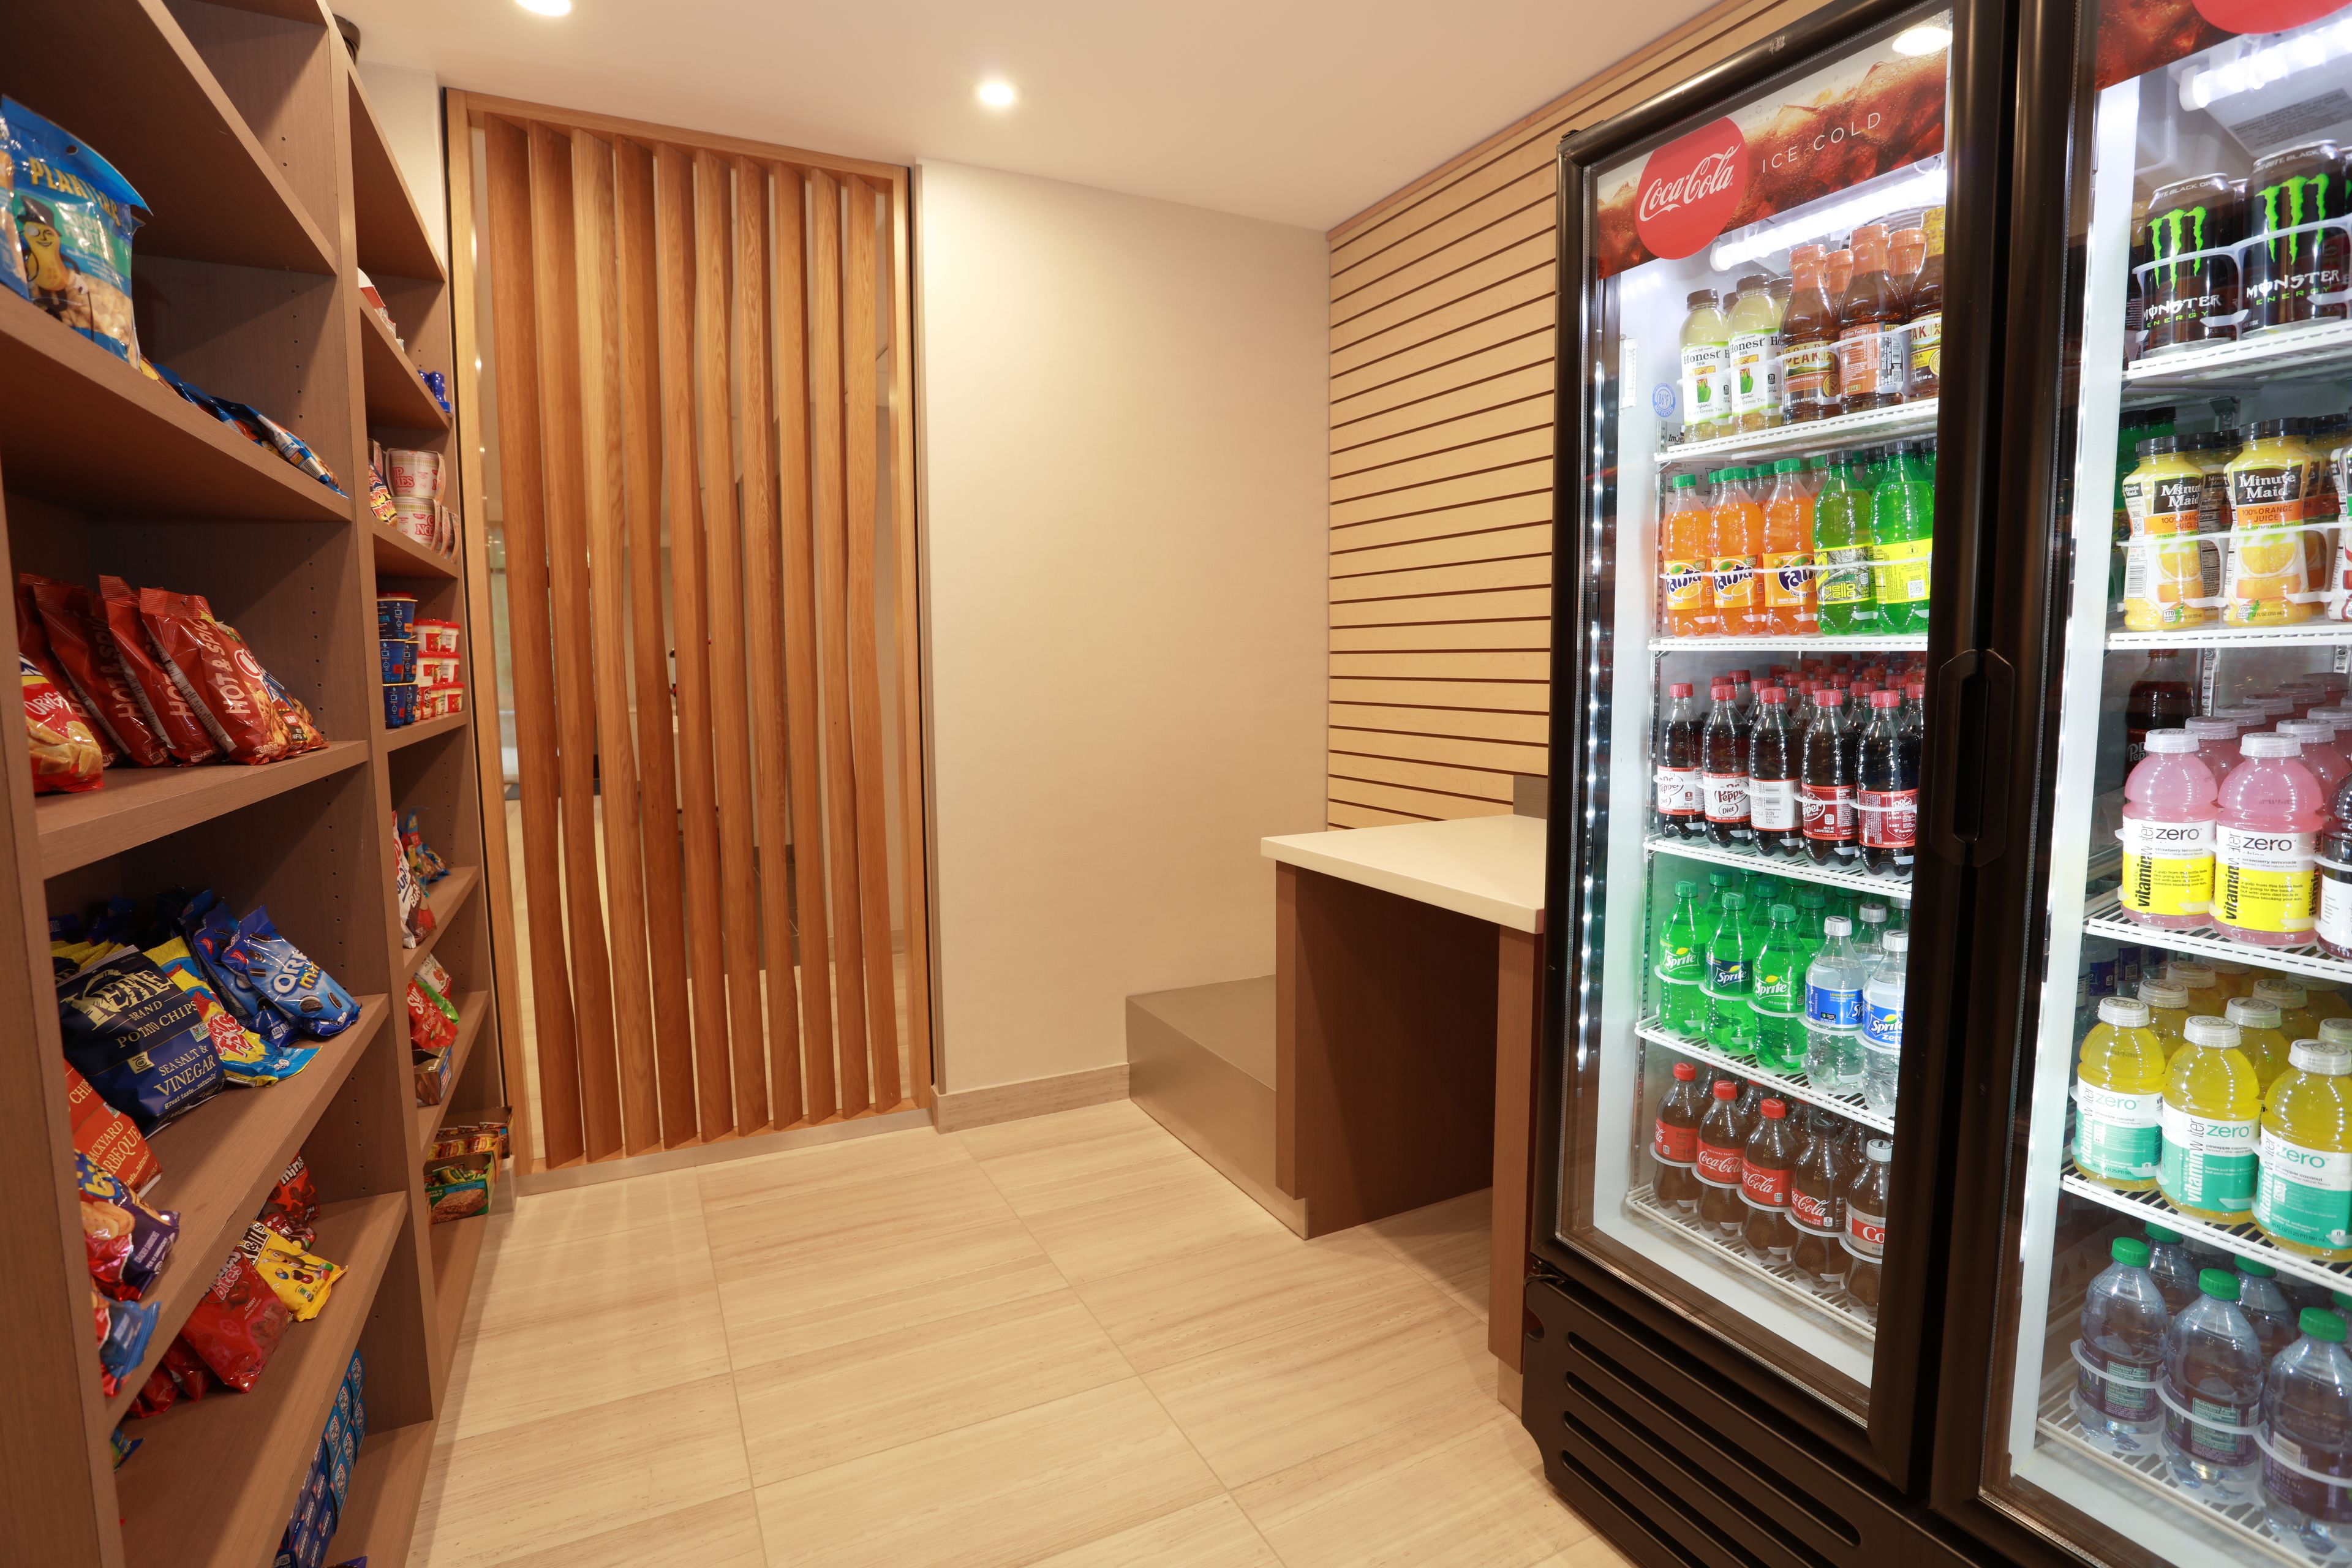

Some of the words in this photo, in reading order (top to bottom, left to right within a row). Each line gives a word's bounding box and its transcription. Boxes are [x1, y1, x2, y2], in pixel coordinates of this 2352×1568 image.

[1762, 148, 1797, 173] ICE
[1814, 112, 1882, 151] COLD
[1639, 142, 1741, 222] Coca-Cola
[2169, 183, 2198, 196] BLACK
[2247, 270, 2340, 299] MONSTER
[2256, 286, 2330, 306] ENERGY
[2144, 294, 2222, 322] MONSTER
[2147, 311, 2209, 328] ENERGY
[1730, 337, 1765, 353] Honest
[1684, 350, 1721, 364] Honest
[2239, 474, 2296, 488] Minute
[2160, 483, 2202, 497] Minut
[2246, 484, 2288, 499] Maid
[2168, 493, 2199, 507] Maid
[2258, 505, 2293, 514] ORANGE
[212, 660, 233, 673] &
[218, 673, 251, 714] HOT
[1717, 789, 1744, 803] Peppe
[2155, 828, 2199, 840] zero
[2242, 837, 2293, 852] zero
[2135, 823, 2154, 907] vitaminwter
[2223, 830, 2241, 920] vitaminwter
[1665, 952, 1696, 968] Sprite
[1717, 969, 1747, 984] Sprite
[1755, 981, 1788, 995] Sprite
[60, 969, 175, 1031] KETTLE
[129, 1000, 163, 1022] BRAND
[116, 1021, 160, 1049] POTATO
[159, 1000, 198, 1027] CHIPS
[272, 1027, 281, 1035] 140
[158, 1061, 179, 1077] SEA
[178, 1049, 198, 1067] SALT
[198, 1044, 209, 1054] &
[153, 1054, 217, 1096] VINEGAR
[164, 1096, 182, 1110] great
[2096, 1093, 2137, 1110] zero
[2080, 1087, 2094, 1164] vitaminwter
[2206, 1125, 2250, 1138] zero
[86, 1120, 124, 1163] BACKYARD
[102, 1125, 141, 1175] ARBEQUE
[2184, 1118, 2205, 1202] vitaminwter
[2276, 1147, 2326, 1169] zero
[2299, 1173, 2323, 1182] coconut
[2271, 1213, 2291, 1224] nutrient
[2291, 1220, 2320, 1232] enhanced
[2271, 1216, 2285, 1225] water
[2285, 1222, 2312, 1234] beverage
[145, 1260, 154, 1270] PER
[215, 1263, 243, 1300] bites
[244, 1297, 256, 1312] CHERRY
